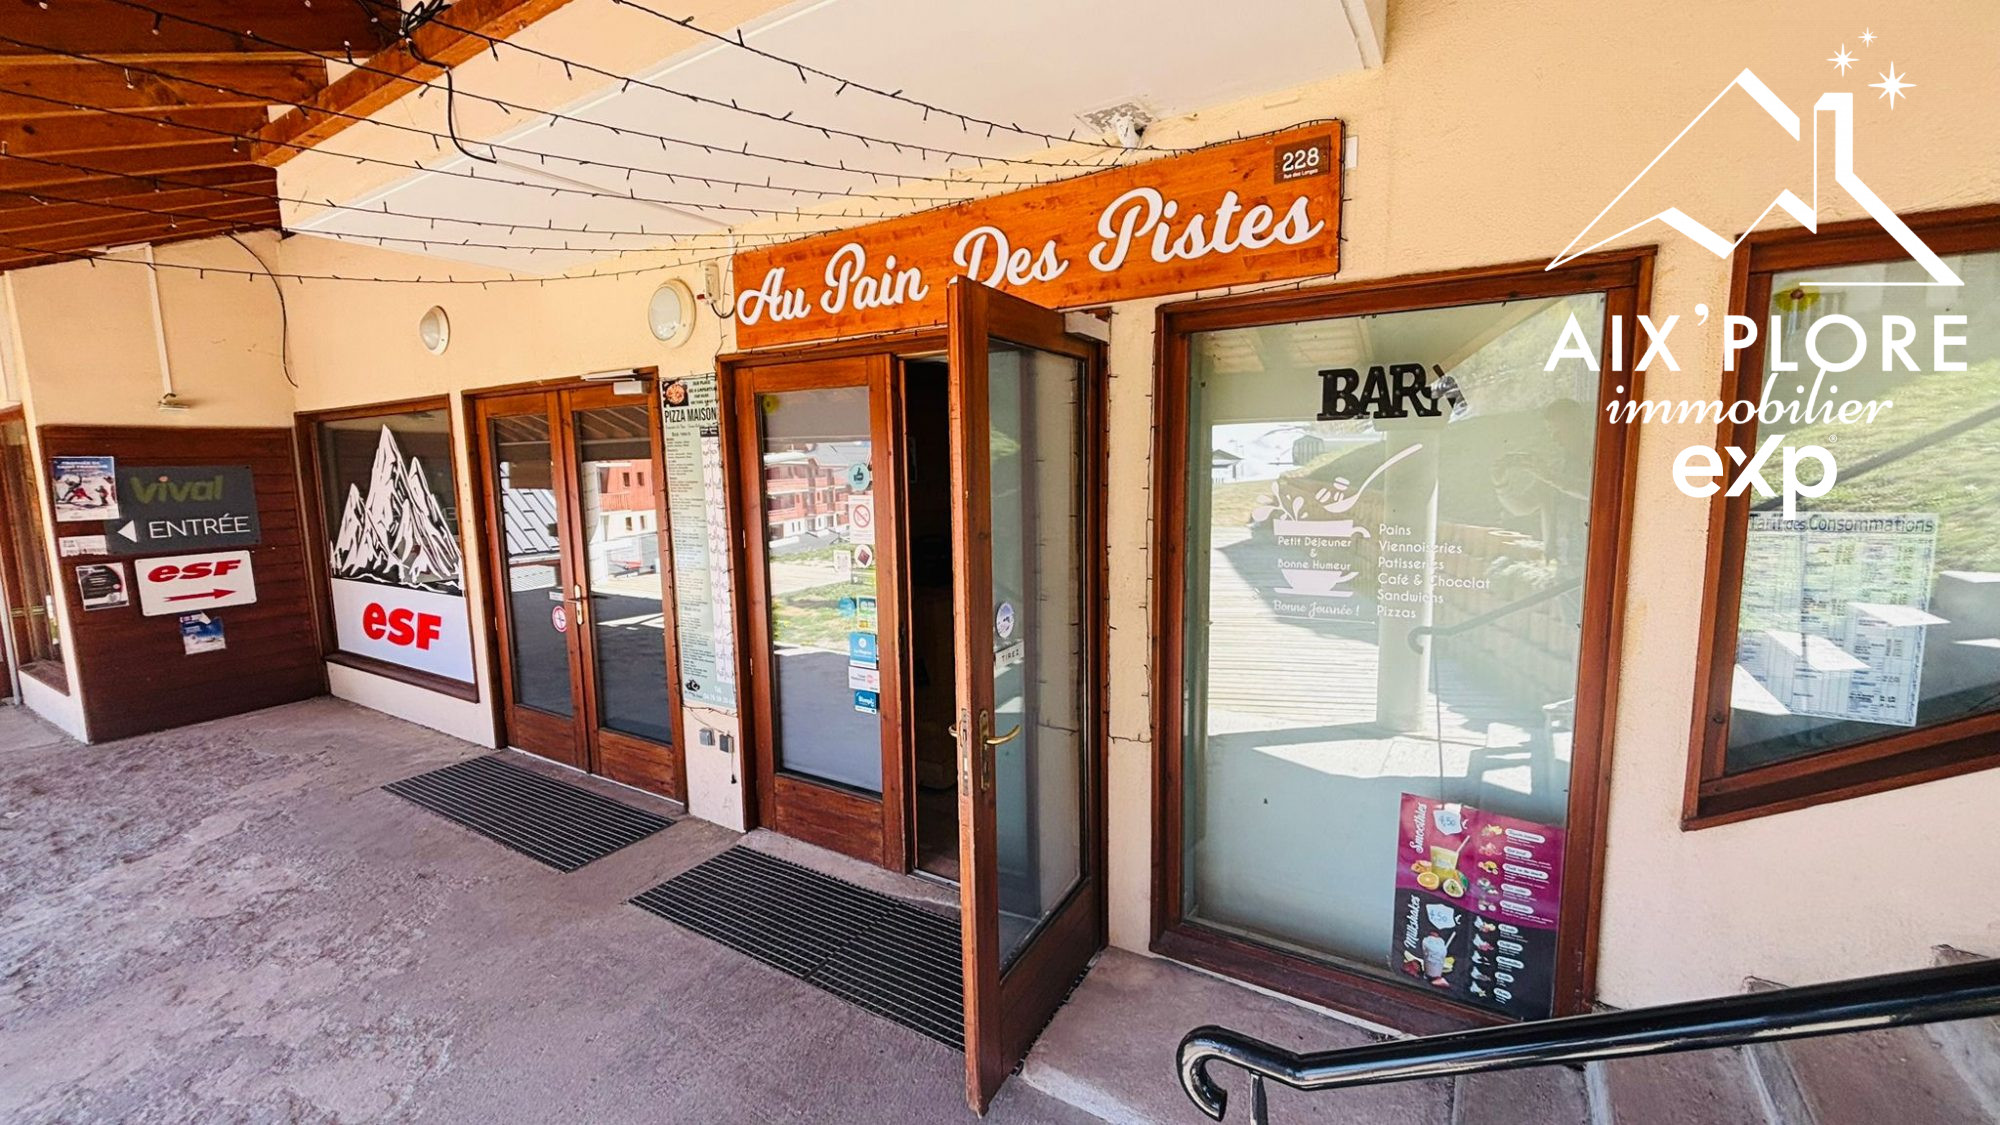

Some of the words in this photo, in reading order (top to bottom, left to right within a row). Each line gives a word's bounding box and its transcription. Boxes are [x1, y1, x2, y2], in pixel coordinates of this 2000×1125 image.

[1283, 147, 1319, 171] 228
[736, 266, 811, 327] Au
[820, 242, 928, 310] Pain
[953, 226, 1069, 288] Des
[1088, 186, 1326, 273] Pistes
[1316, 363, 1442, 422] BAR
[664, 408, 686, 423] PIZZA
[687, 406, 717, 422] MAISON
[148, 512, 251, 539] ENTRÉE
[1379, 523, 1412, 536] Pains
[1808, 514, 1934, 533] Consommations
[1278, 536, 1302, 546] Petit
[1304, 536, 1352, 548] Déjeuner
[1379, 540, 1463, 554] Viennoiseries
[1309, 548, 1318, 558] &
[1278, 558, 1310, 569] Bonne
[1312, 559, 1352, 571] Humeur
[1377, 572, 1409, 586] Café
[1413, 574, 1424, 586] &
[1429, 575, 1491, 589] Chocolat
[1273, 599, 1307, 613] Bonne
[1308, 601, 1353, 618] Journée
[1377, 604, 1416, 619] Pizzas
[1002, 649, 1019, 661] TIREZ
[1409, 803, 1428, 854] Smoothies
[1403, 895, 1421, 949] Milkshakes
